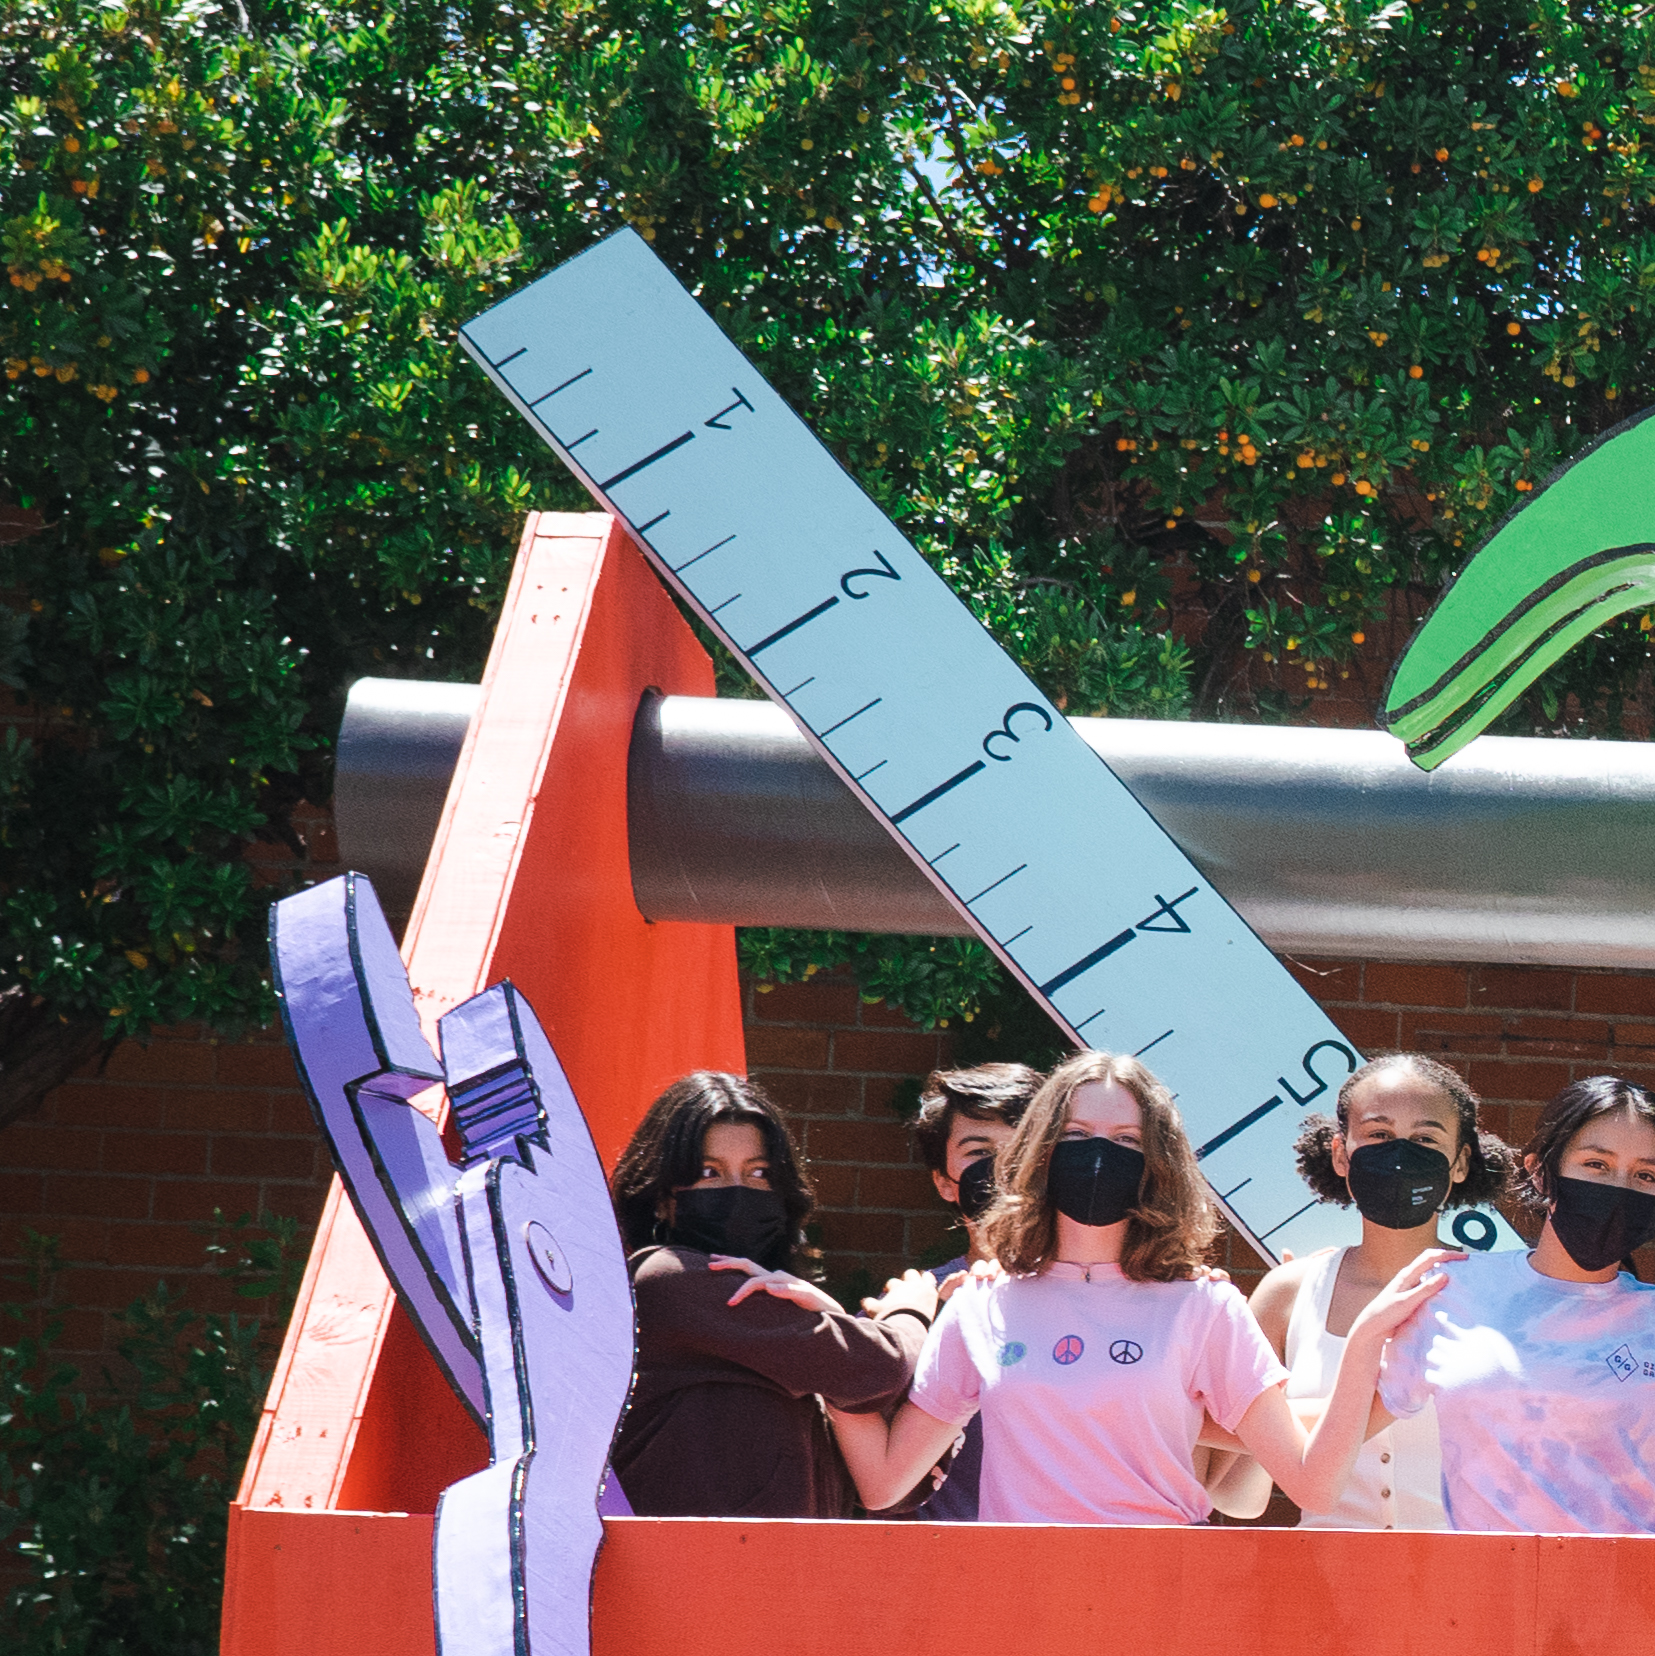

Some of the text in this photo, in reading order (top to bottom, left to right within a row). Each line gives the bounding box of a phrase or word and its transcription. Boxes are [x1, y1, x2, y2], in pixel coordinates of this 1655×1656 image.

[704, 386, 1357, 1107] 1 2 3 4 5
